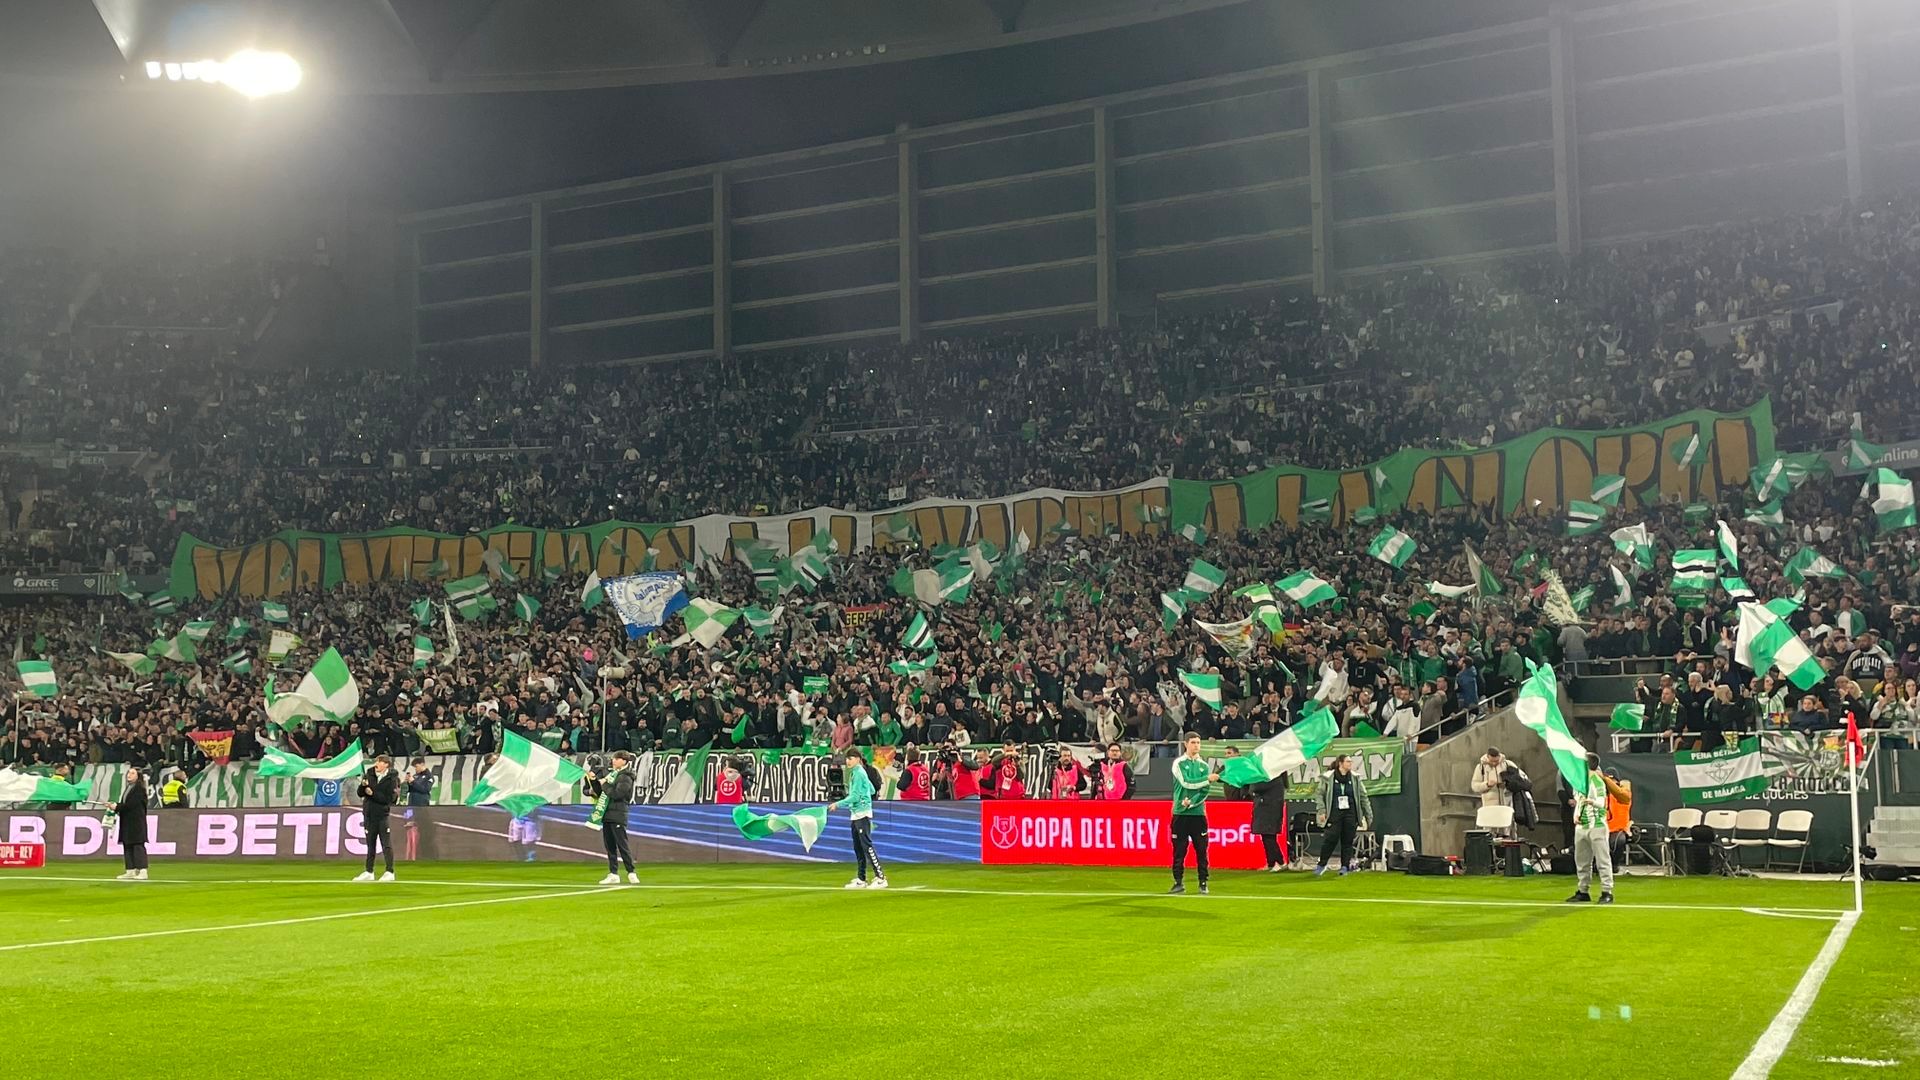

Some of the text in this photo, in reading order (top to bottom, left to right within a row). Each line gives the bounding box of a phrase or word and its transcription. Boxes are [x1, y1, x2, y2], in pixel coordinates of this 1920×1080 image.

[1021, 816, 1160, 849] COPA DEL REY
